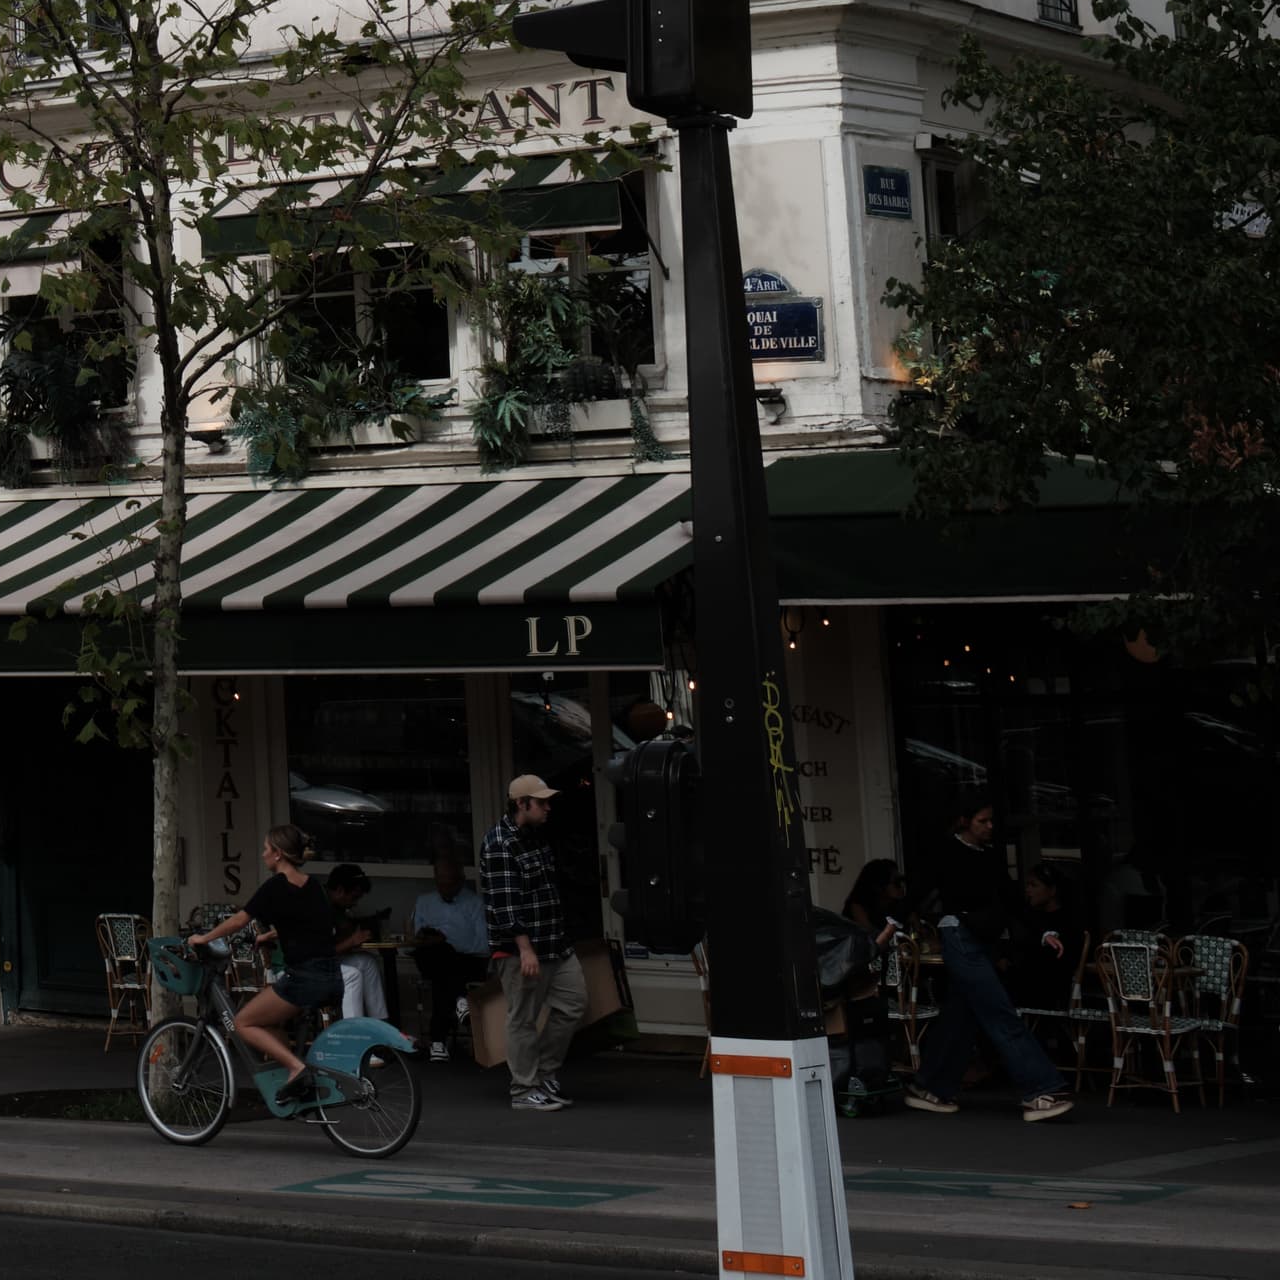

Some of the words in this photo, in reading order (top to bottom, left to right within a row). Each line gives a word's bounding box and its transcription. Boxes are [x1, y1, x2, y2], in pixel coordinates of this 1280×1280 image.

[880, 177, 896, 190] RUE
[868, 192, 882, 206] DES
[746, 311, 778, 326] QUAI
[753, 325, 772, 336] DE
[761, 337, 778, 349] DE
[779, 335, 817, 350] VILLE
[524, 614, 593, 656] LP
